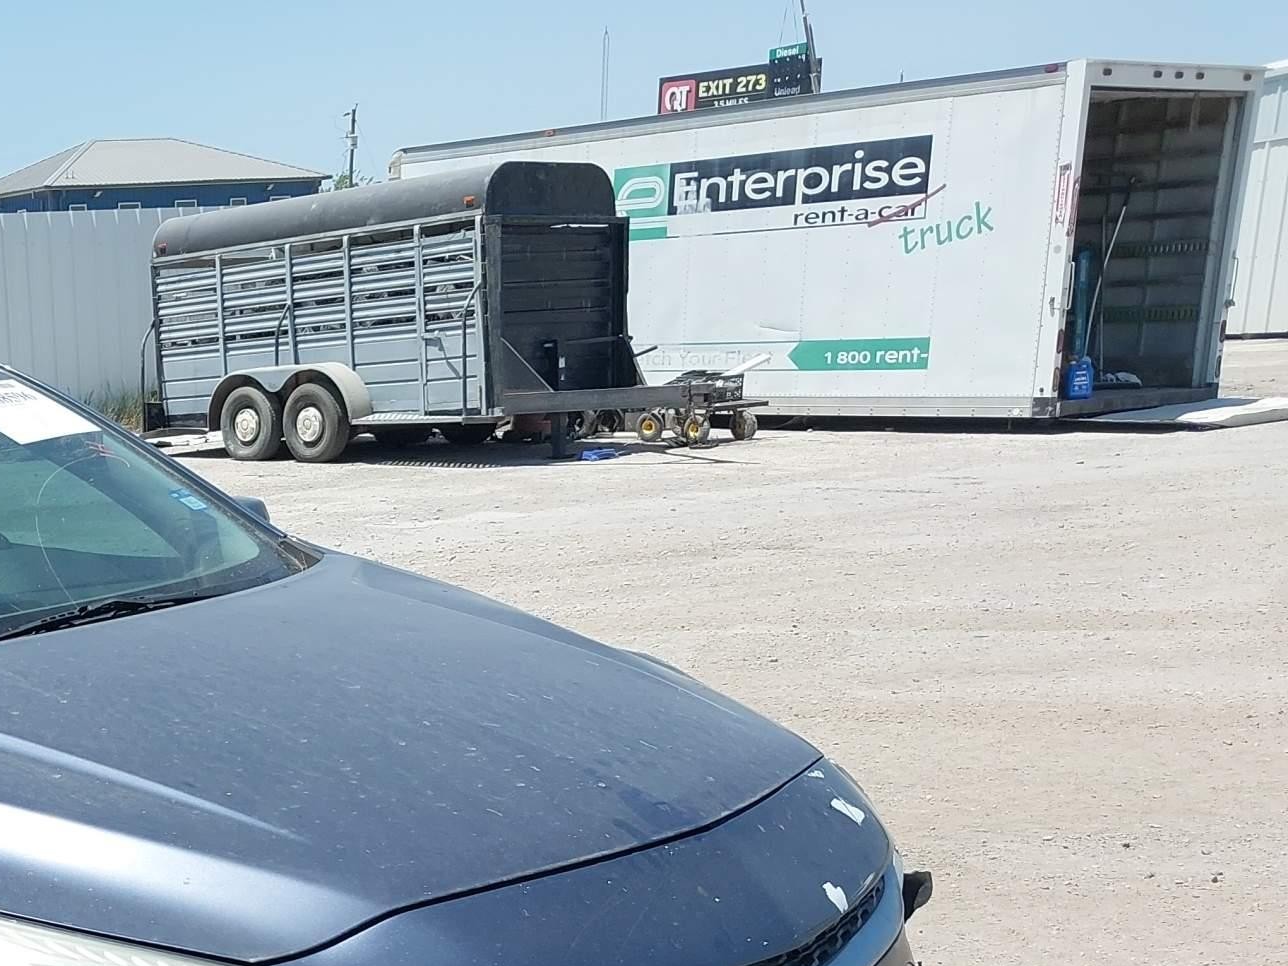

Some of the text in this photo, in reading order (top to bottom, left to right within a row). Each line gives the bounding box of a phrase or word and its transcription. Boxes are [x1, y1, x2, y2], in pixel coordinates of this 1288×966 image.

[776, 46, 799, 58] Diesel
[698, 73, 767, 98] EXIT 273
[665, 85, 691, 112] QT
[673, 149, 927, 207] Enterprise
[793, 200, 922, 226] rent-a-car
[898, 201, 995, 255] truck
[679, 350, 722, 366] Your
[824, 345, 929, 365] 1 800 rent-
